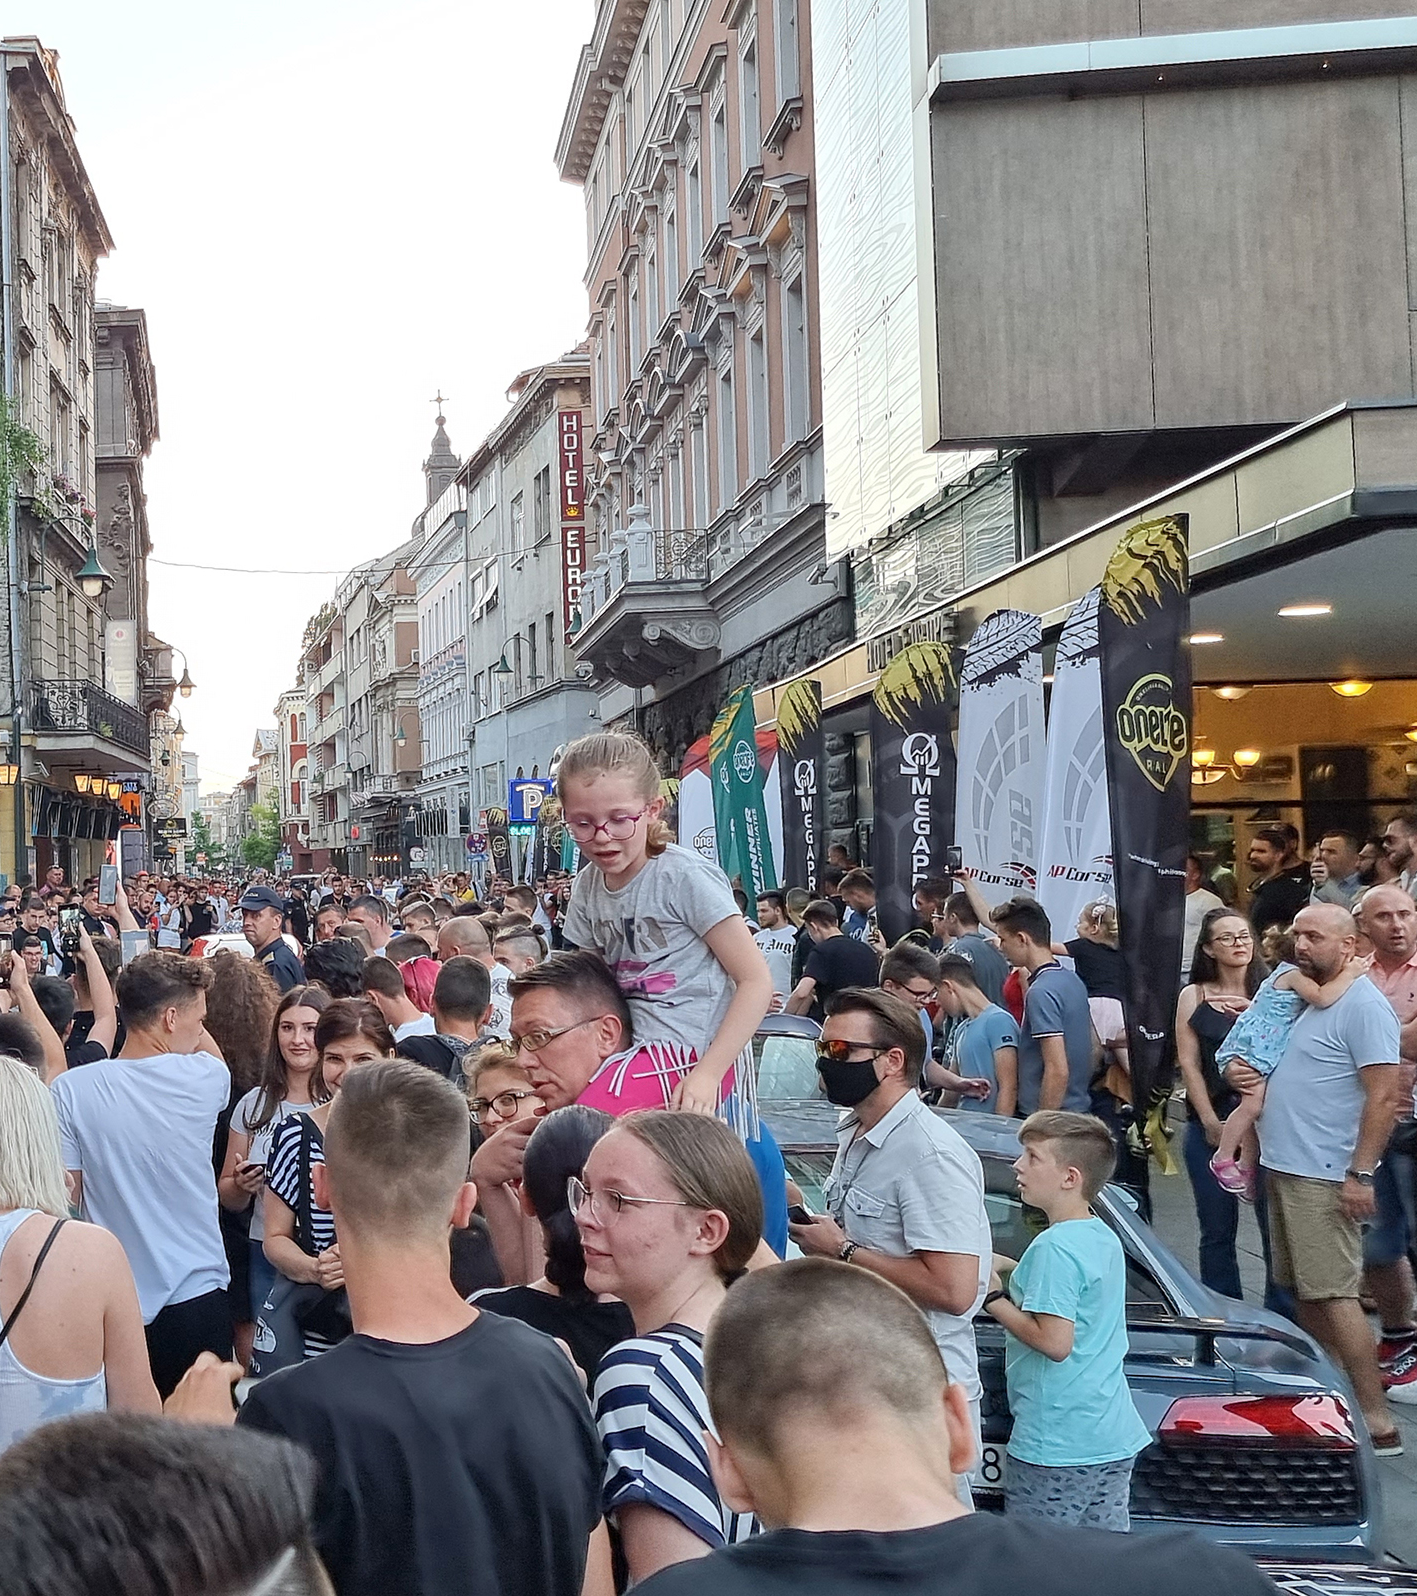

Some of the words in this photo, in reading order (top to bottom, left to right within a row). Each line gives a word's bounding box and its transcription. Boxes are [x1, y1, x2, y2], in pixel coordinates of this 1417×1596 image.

[562, 414, 580, 506] HOTEL
[744, 807, 763, 897] WINNER
[752, 808, 764, 864] AFFILIATES
[979, 871, 1024, 888] Corse
[1047, 865, 1067, 878] AP
